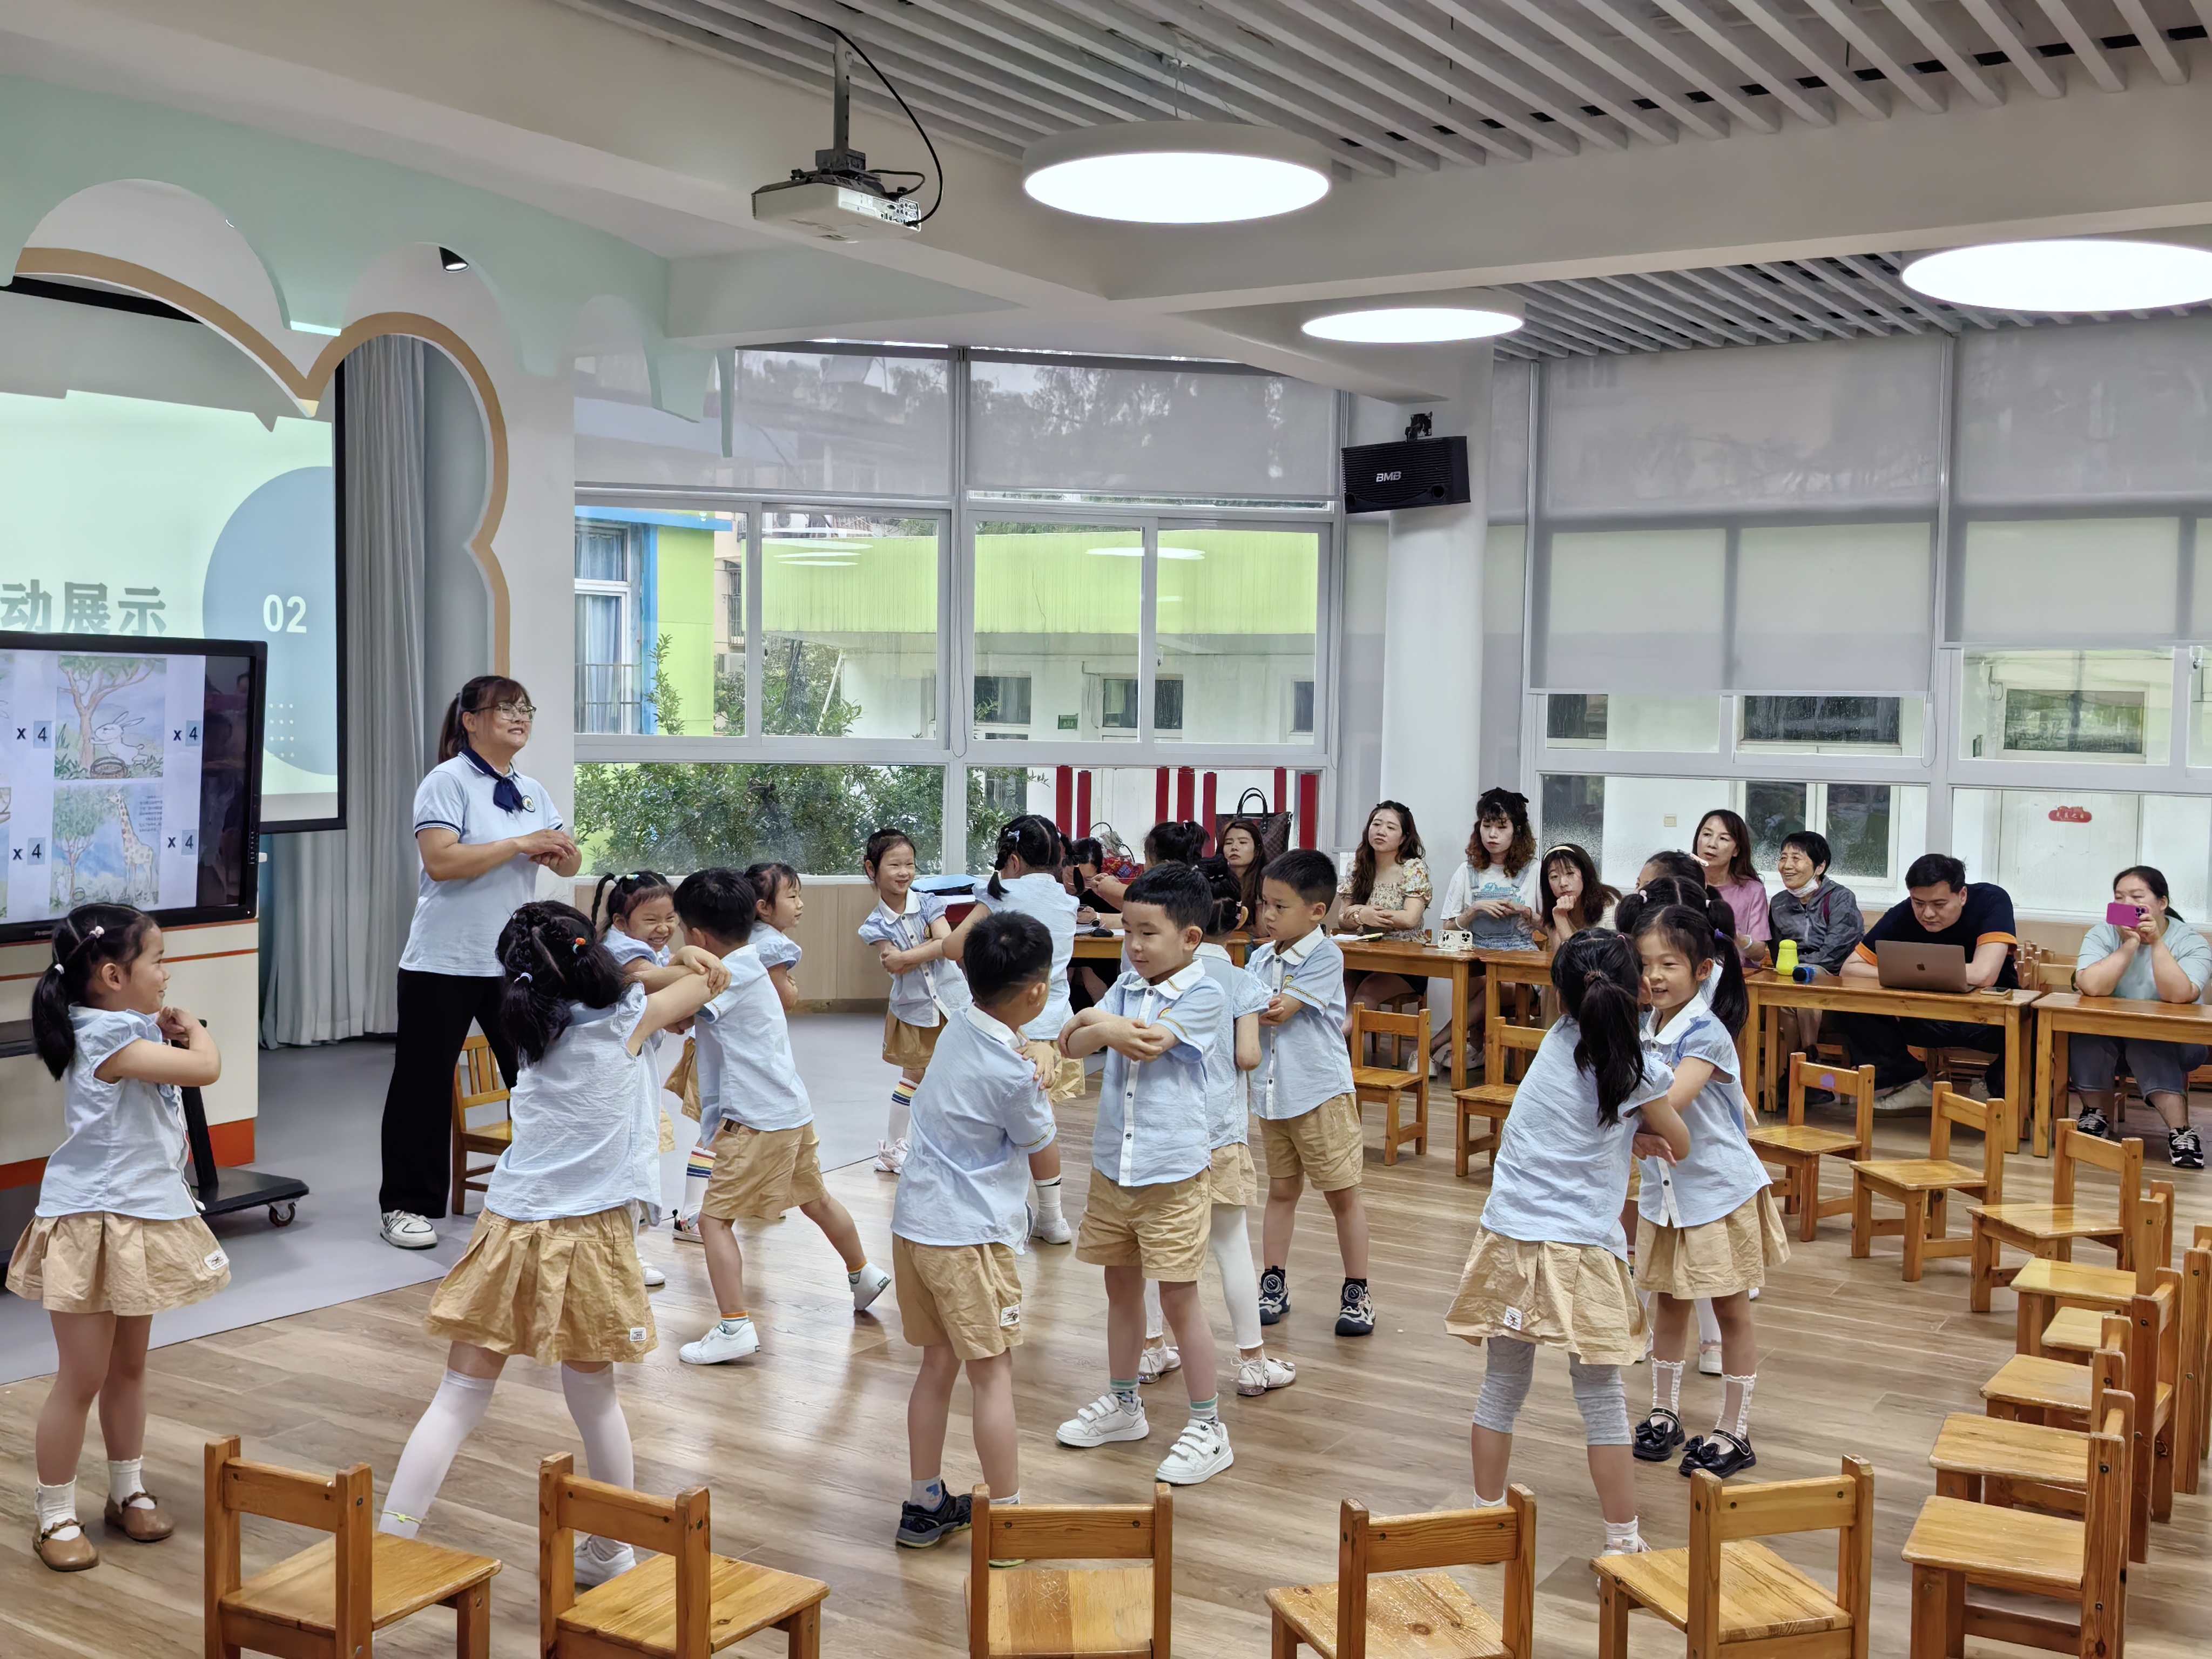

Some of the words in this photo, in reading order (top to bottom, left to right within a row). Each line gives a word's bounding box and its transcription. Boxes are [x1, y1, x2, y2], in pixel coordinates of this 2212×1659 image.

[1376, 471, 1401, 482] BMB
[0, 579, 166, 636] 动展示
[263, 594, 307, 633] 02
